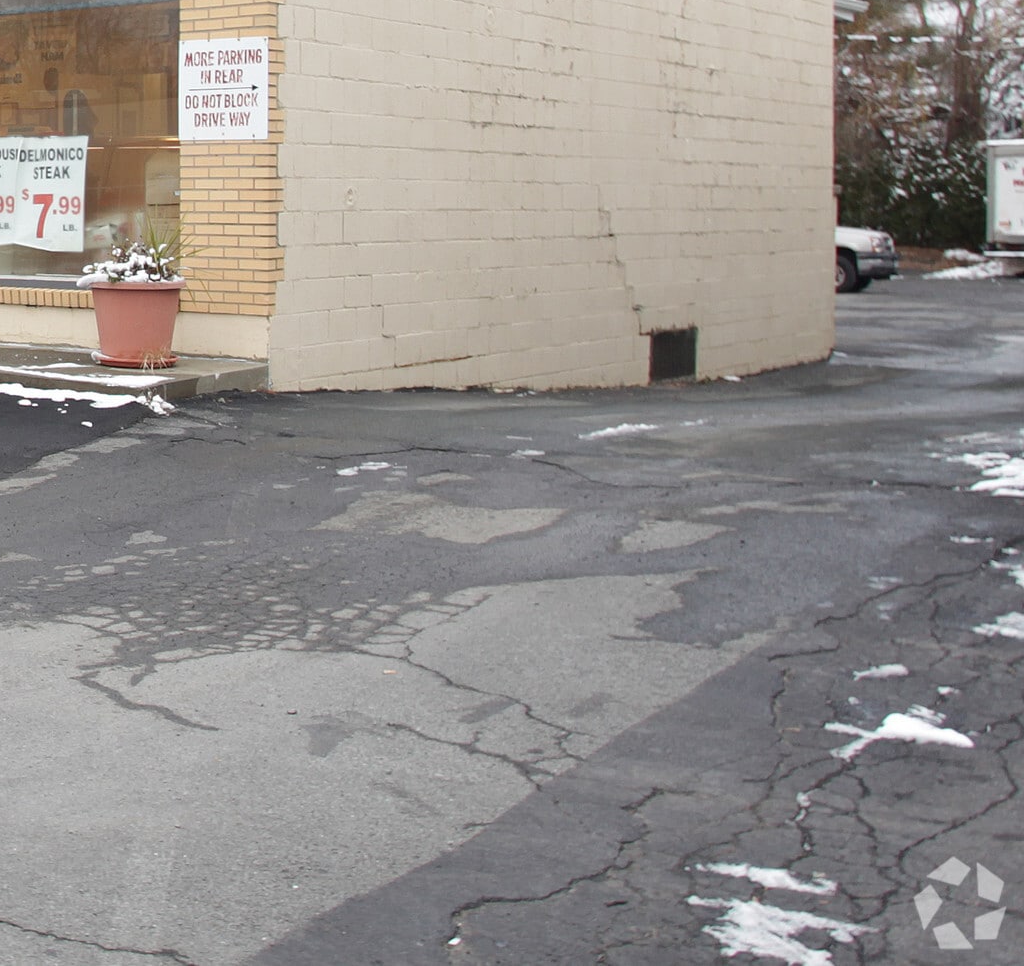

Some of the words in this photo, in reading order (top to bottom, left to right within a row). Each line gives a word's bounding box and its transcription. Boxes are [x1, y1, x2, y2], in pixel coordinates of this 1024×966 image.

[184, 51, 214, 67] MORE
[218, 49, 262, 66] PARKING
[201, 70, 211, 84] IN
[215, 69, 243, 84] REAR
[185, 95, 199, 109] DO
[202, 94, 222, 108] NOT
[224, 93, 258, 108] BLOCK
[19, 147, 84, 163] DELMONICO
[33, 166, 70, 180] STEAK
